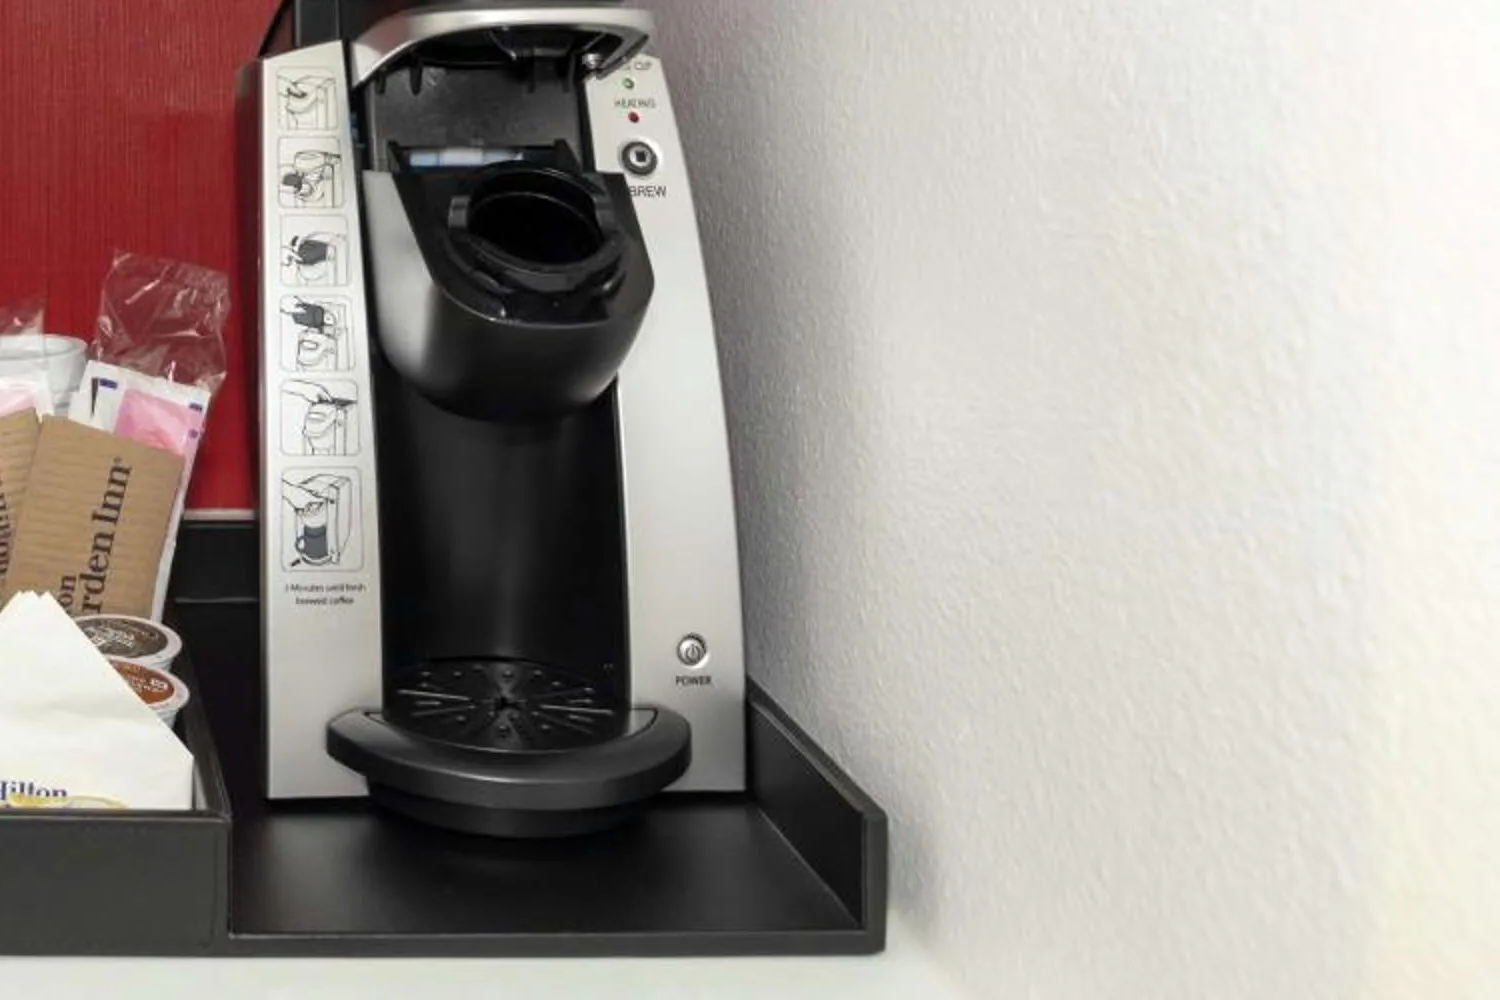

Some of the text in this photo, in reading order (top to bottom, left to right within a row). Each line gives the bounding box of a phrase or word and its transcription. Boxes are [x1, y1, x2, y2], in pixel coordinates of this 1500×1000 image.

[629, 185, 667, 198] BREW
[79, 464, 132, 613] rden Inn
[329, 595, 355, 606] coffee
[675, 675, 712, 686] POWER
